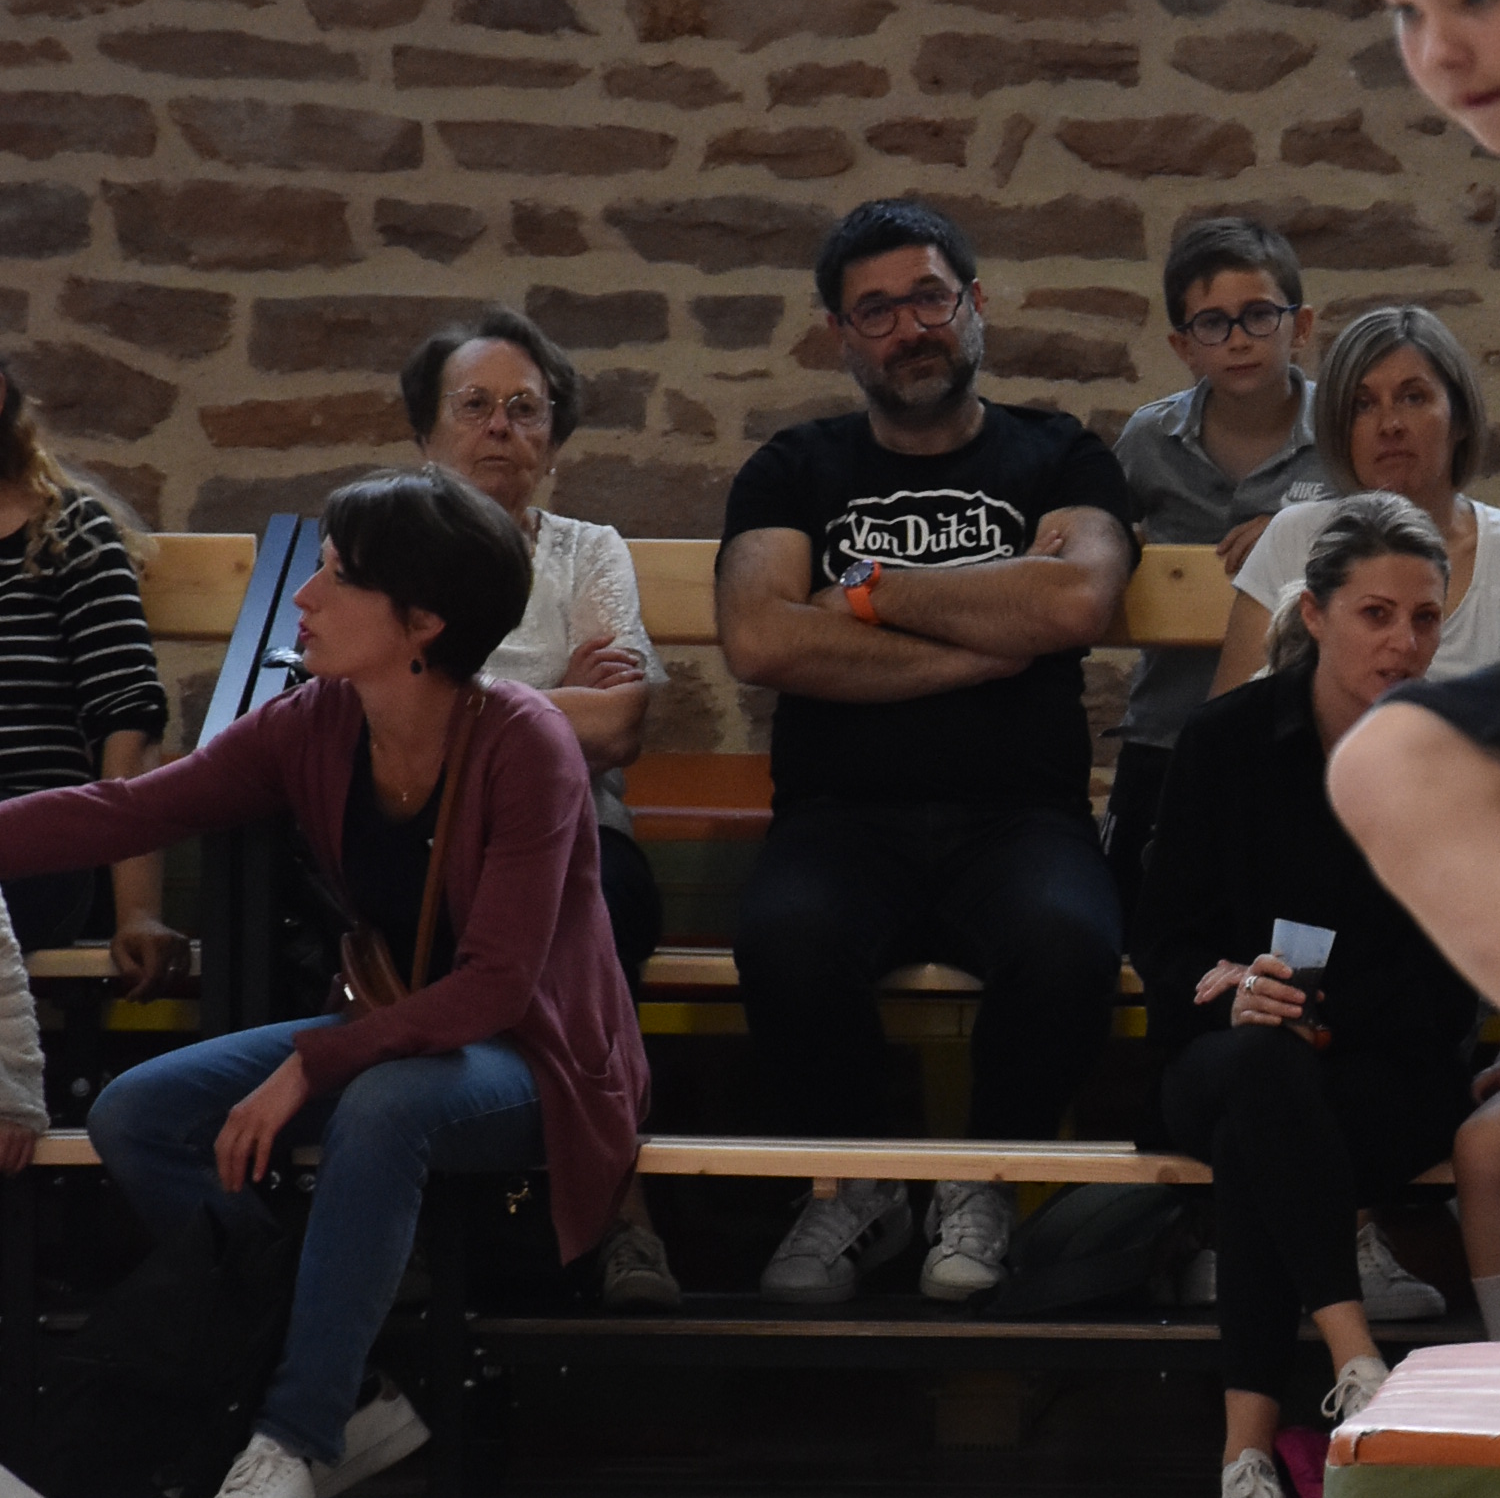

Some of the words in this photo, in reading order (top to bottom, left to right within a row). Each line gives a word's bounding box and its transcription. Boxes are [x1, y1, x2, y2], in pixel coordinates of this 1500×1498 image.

[1288, 481, 1324, 500] NIKE
[846, 511, 903, 556] Von
[901, 505, 1002, 556] Dutch
